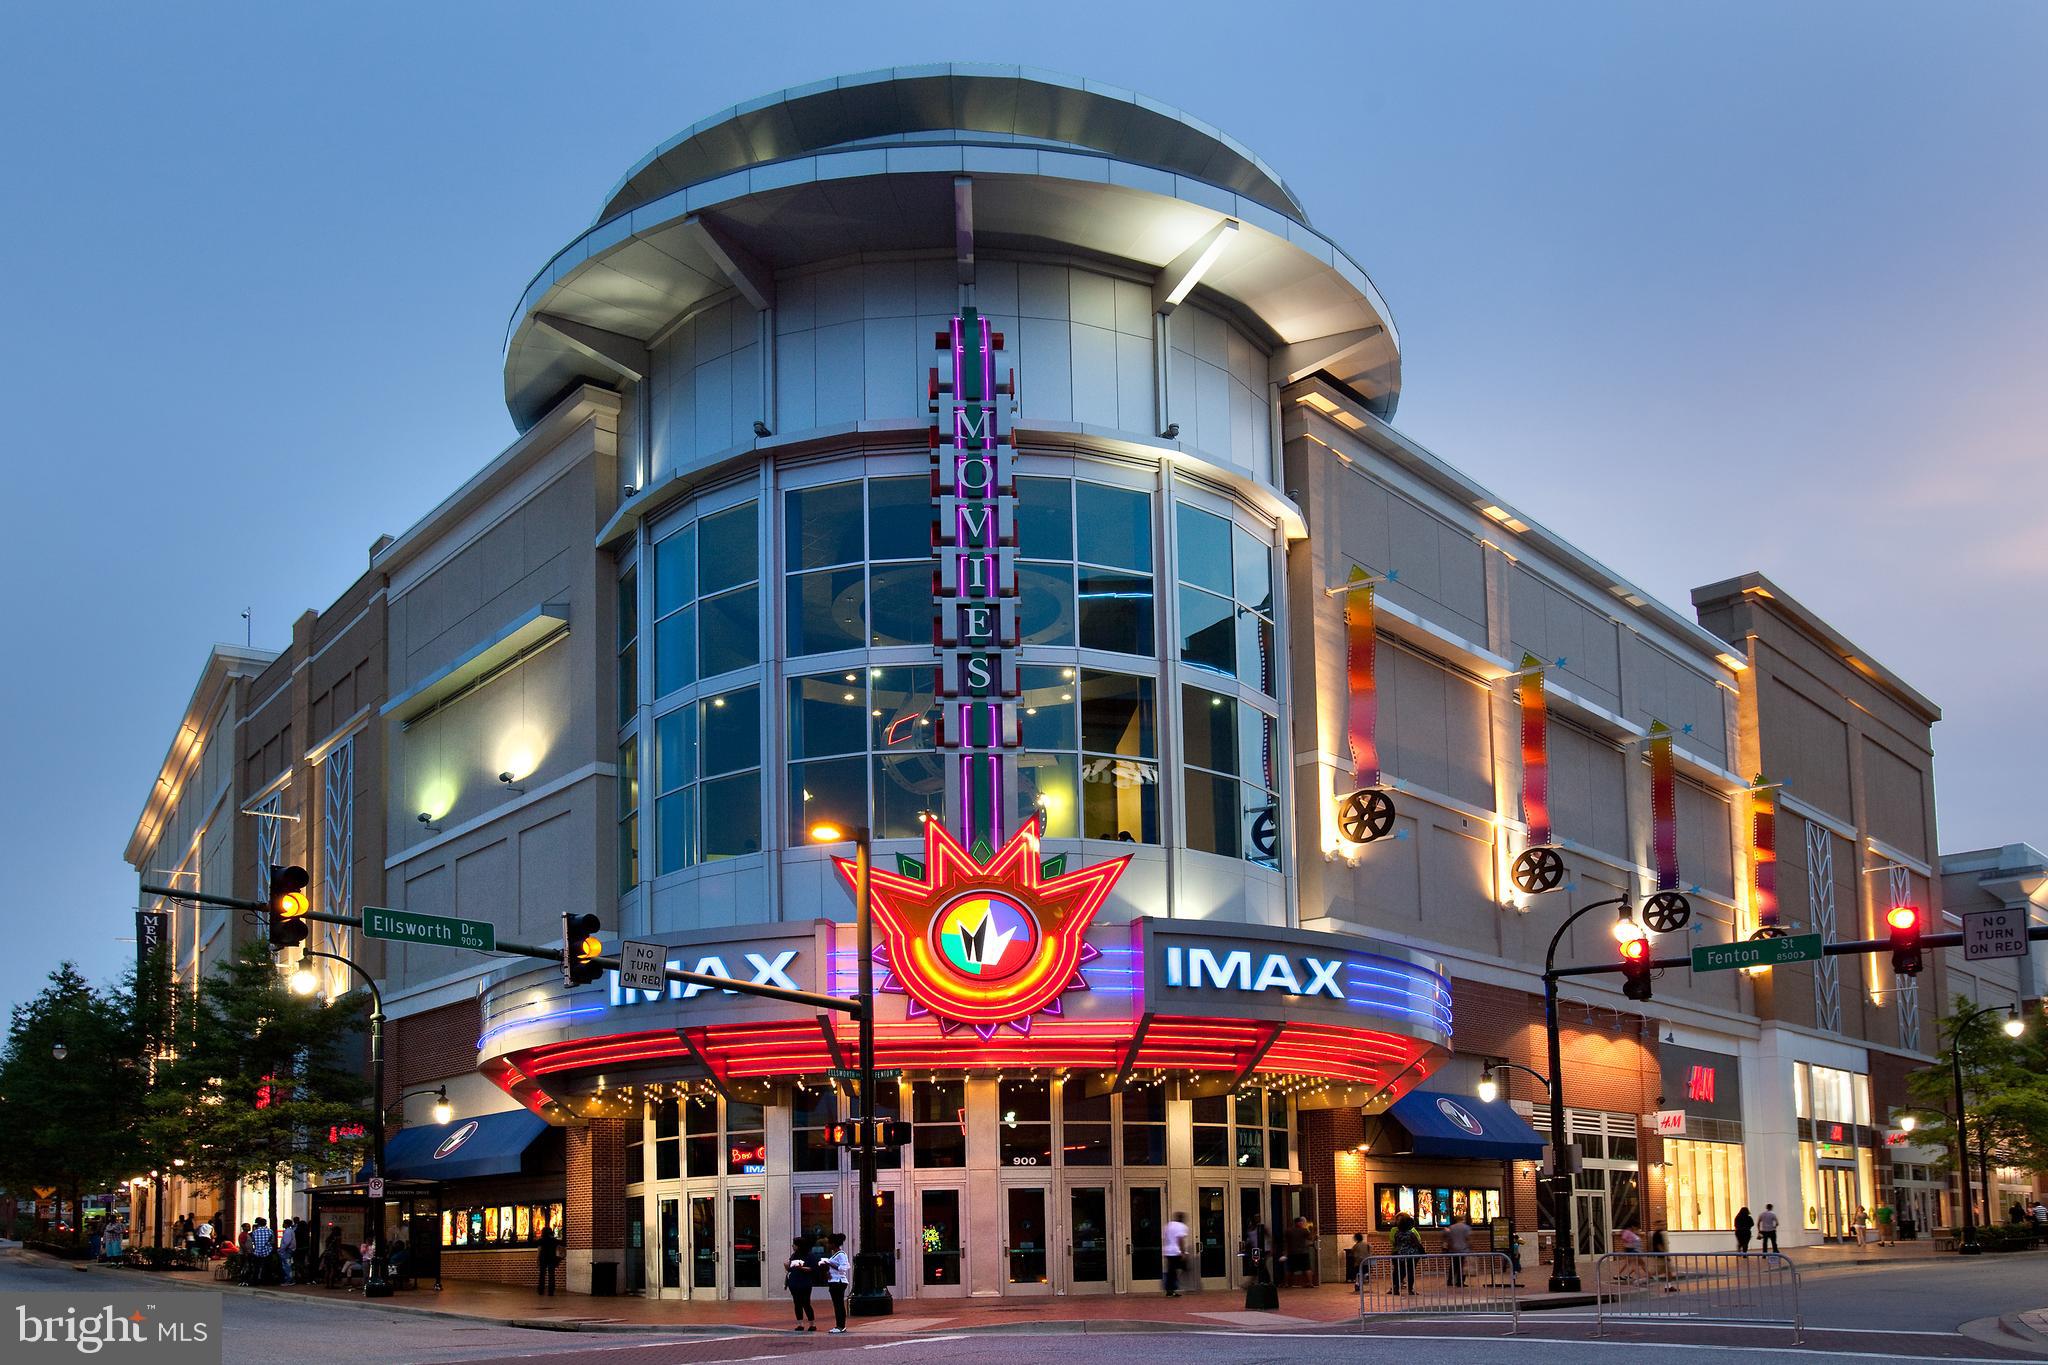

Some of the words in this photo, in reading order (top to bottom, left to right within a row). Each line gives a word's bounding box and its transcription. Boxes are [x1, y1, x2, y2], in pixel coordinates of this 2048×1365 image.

[954, 410, 995, 688] MOVIES
[374, 915, 452, 940] Ellsworth
[462, 923, 475, 936] Dr
[1983, 916, 2006, 927] NO
[1976, 928, 2014, 940] TURN
[461, 937, 477, 947] 900
[1970, 944, 1988, 954] ON
[1995, 941, 2023, 952] RED
[637, 948, 654, 959] NO
[1707, 949, 1759, 965] Fenton
[1781, 938, 1794, 950] St
[1776, 951, 1799, 961] 8500
[630, 960, 657, 972] TURN
[1166, 946, 1346, 999] IMAX
[623, 972, 637, 983] ON
[641, 974, 661, 986] RED
[874, 1070, 893, 1079] FENTON
[1013, 1156, 1037, 1166] 900
